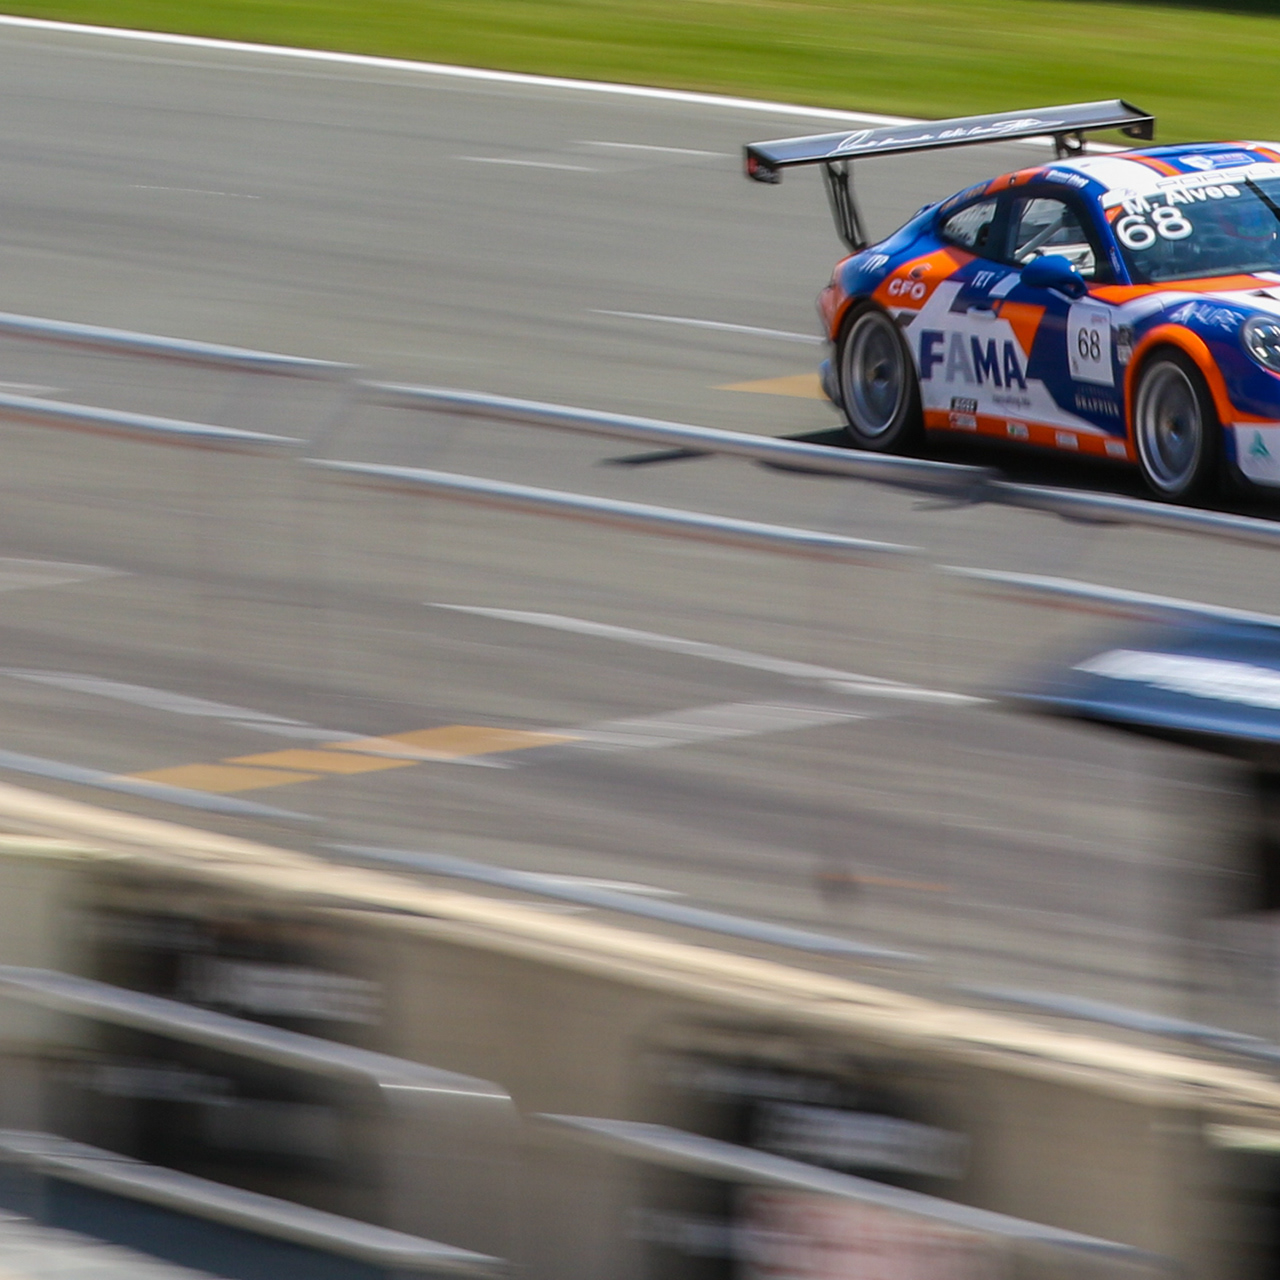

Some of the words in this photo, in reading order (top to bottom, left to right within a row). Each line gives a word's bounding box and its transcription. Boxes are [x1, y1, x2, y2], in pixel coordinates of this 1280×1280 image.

[1122, 197, 1159, 216] M.
[1165, 184, 1241, 206] Alves
[1116, 206, 1193, 251] 68
[888, 278, 927, 300] CFO
[920, 330, 1028, 390] FAMA
[1077, 327, 1101, 364] 68
